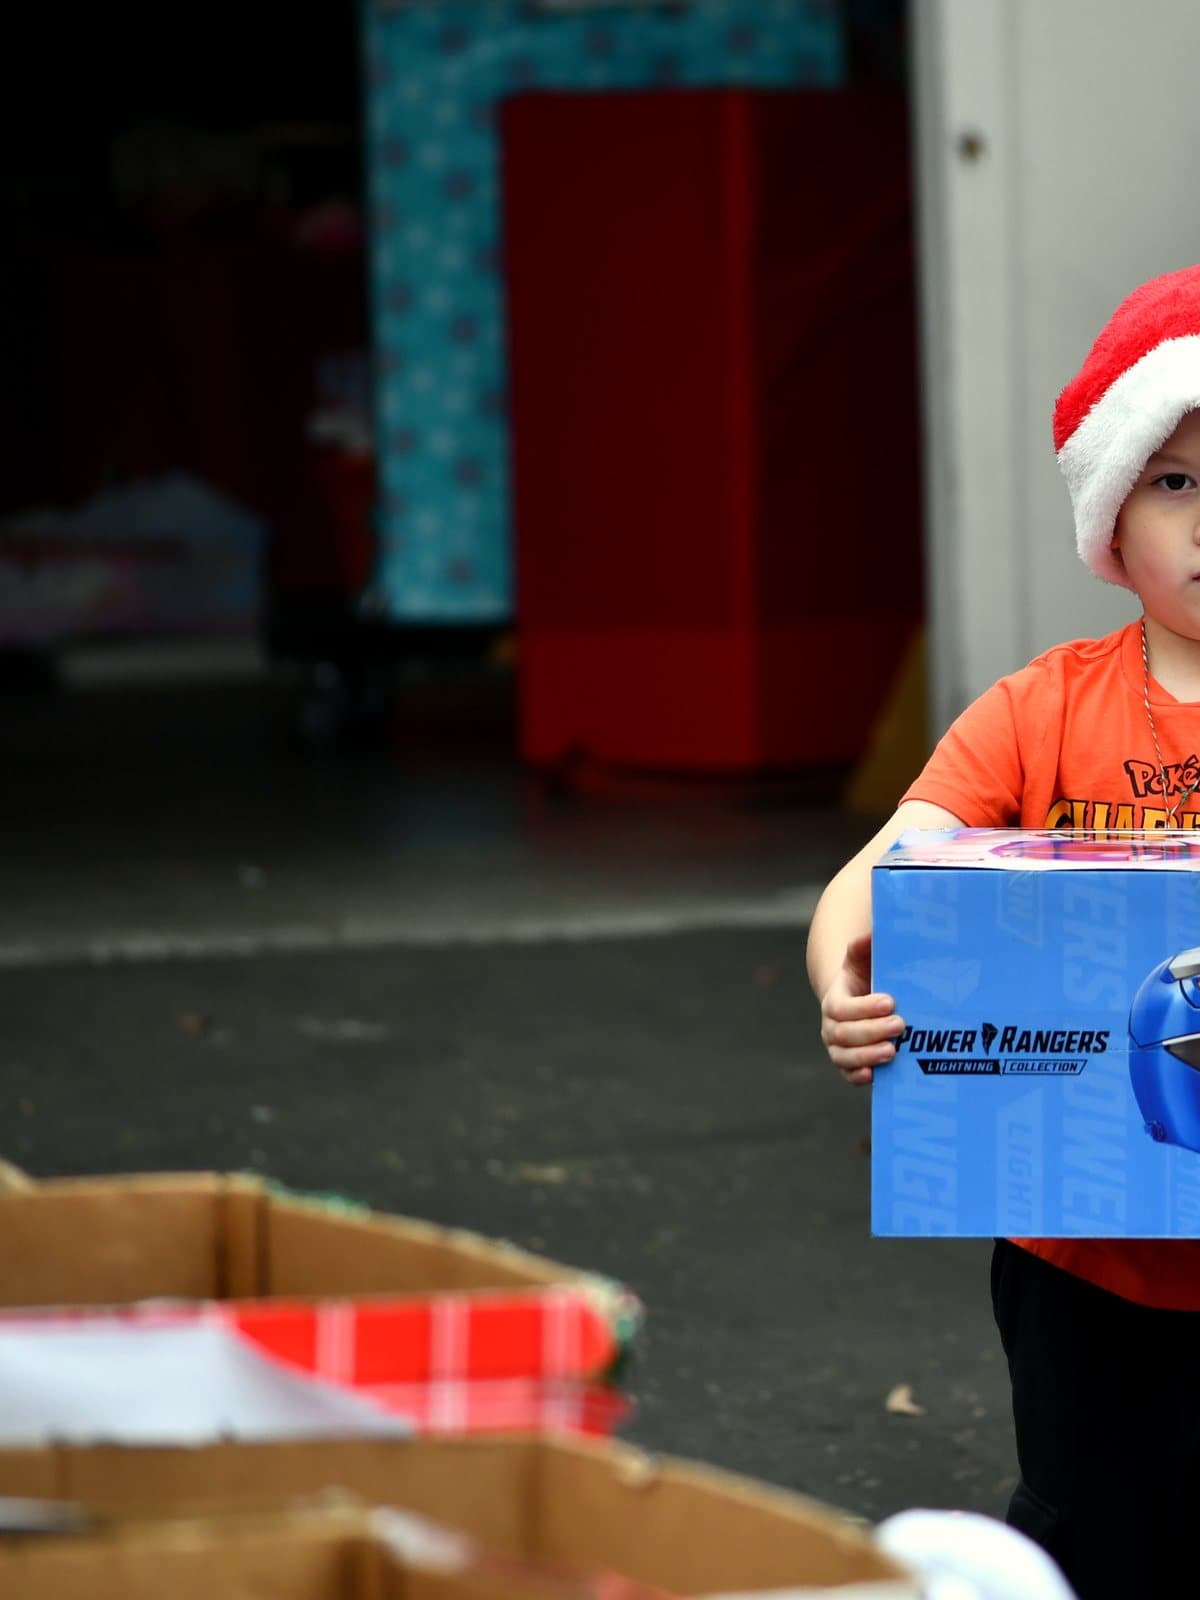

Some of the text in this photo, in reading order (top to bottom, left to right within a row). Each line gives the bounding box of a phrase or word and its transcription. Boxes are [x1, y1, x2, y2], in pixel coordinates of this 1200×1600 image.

[894, 1025, 1110, 1054] POWER RANGERS
[928, 1061, 1078, 1073] LIGHTNING COLLECTION
